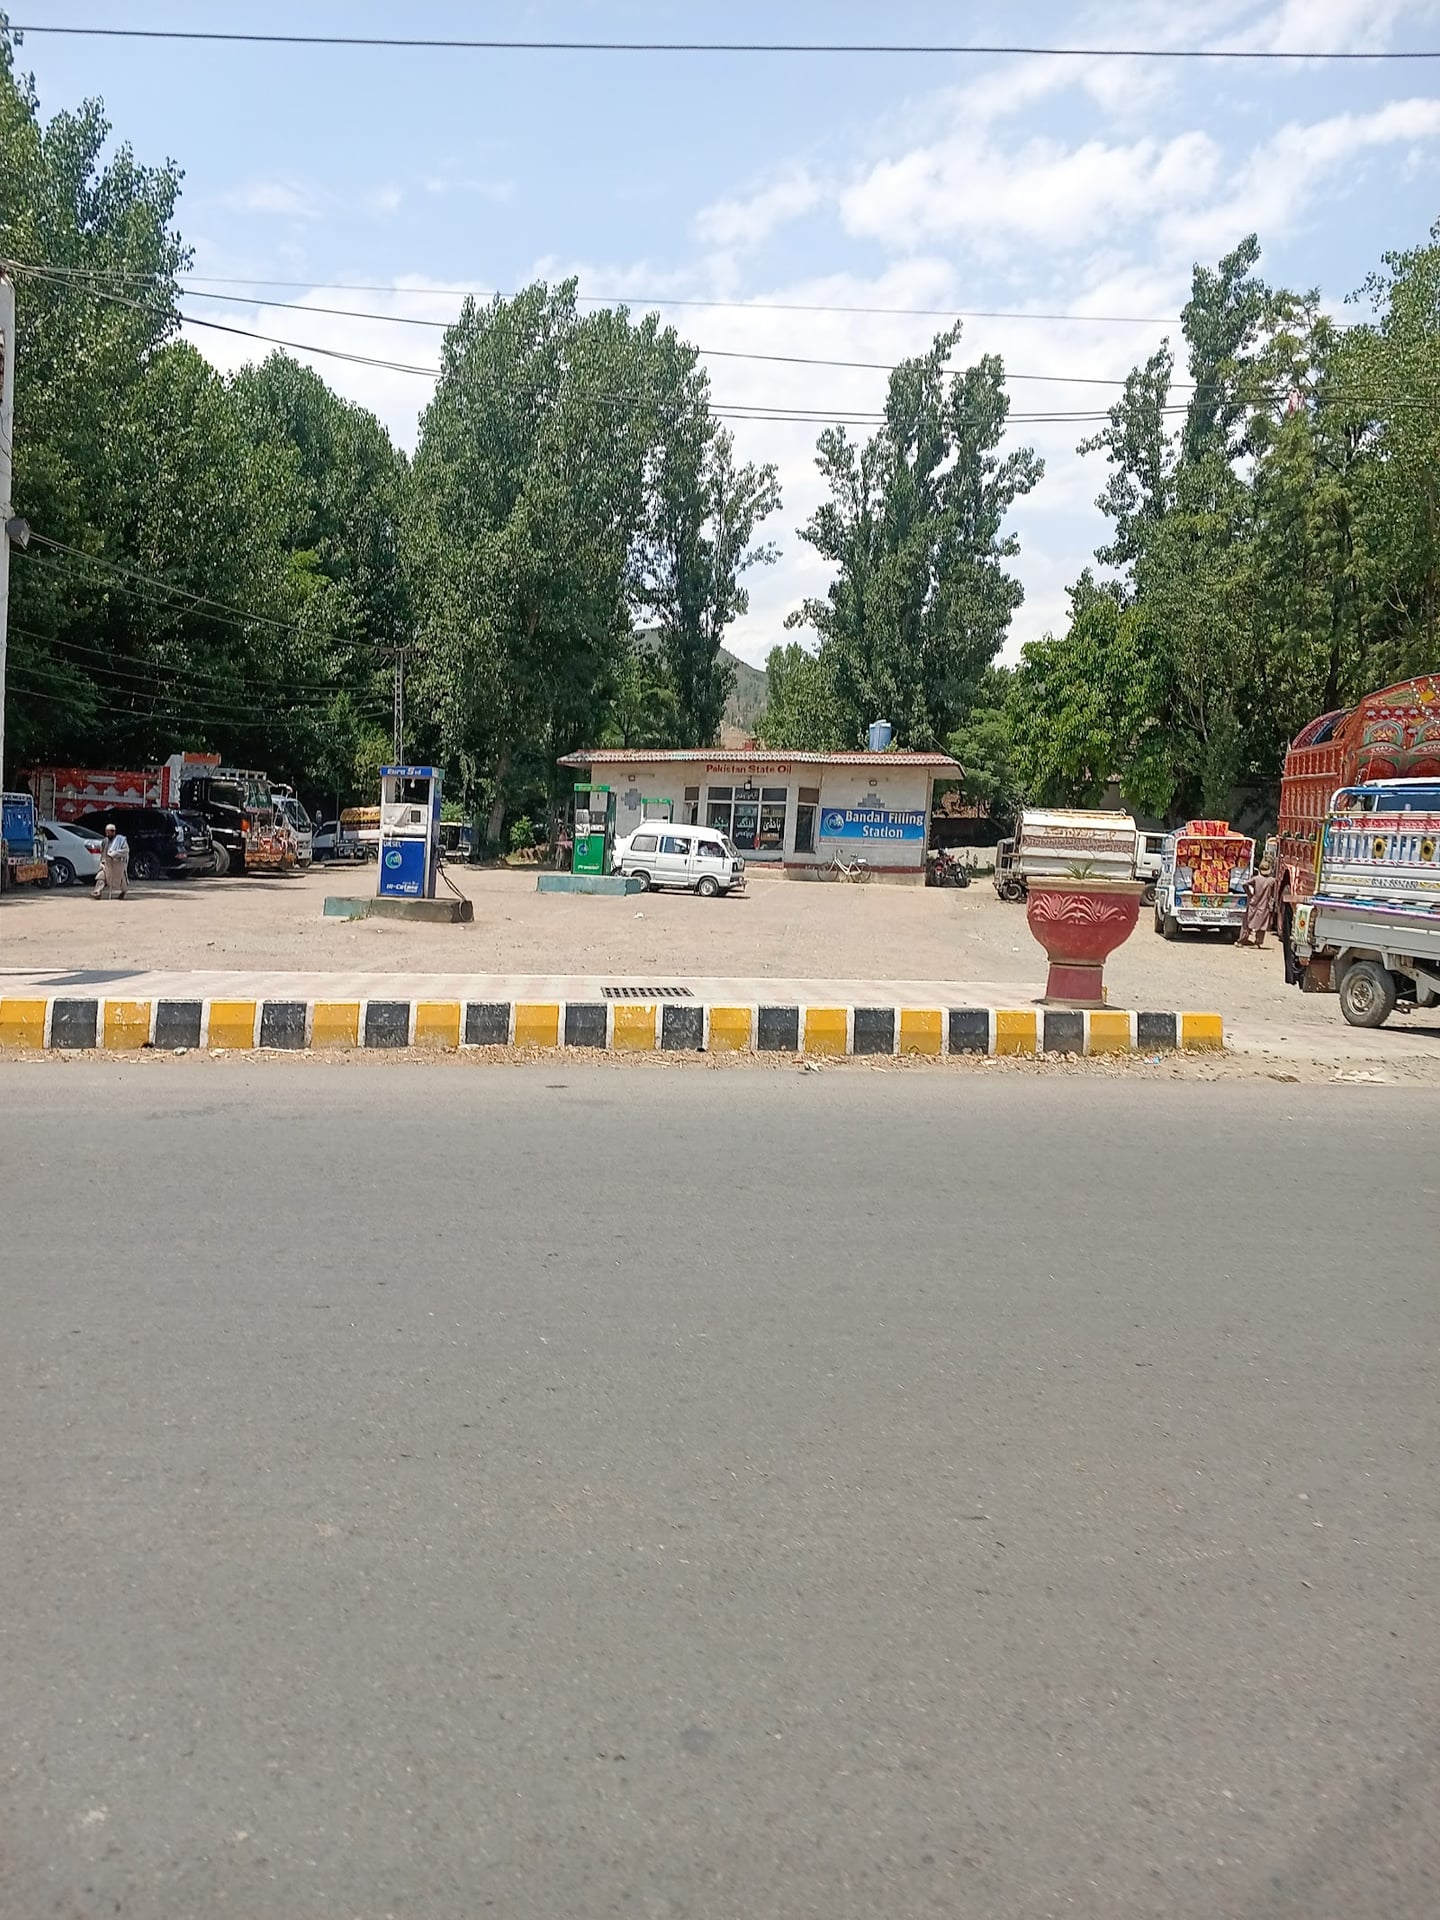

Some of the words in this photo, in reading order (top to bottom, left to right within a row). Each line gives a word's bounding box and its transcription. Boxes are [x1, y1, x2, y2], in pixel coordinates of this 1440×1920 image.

[706, 764, 746, 773] Pakistan
[748, 764, 775, 773] State
[777, 764, 792, 774] Oil
[888, 812, 924, 826] Filling
[862, 825, 903, 838] Station
